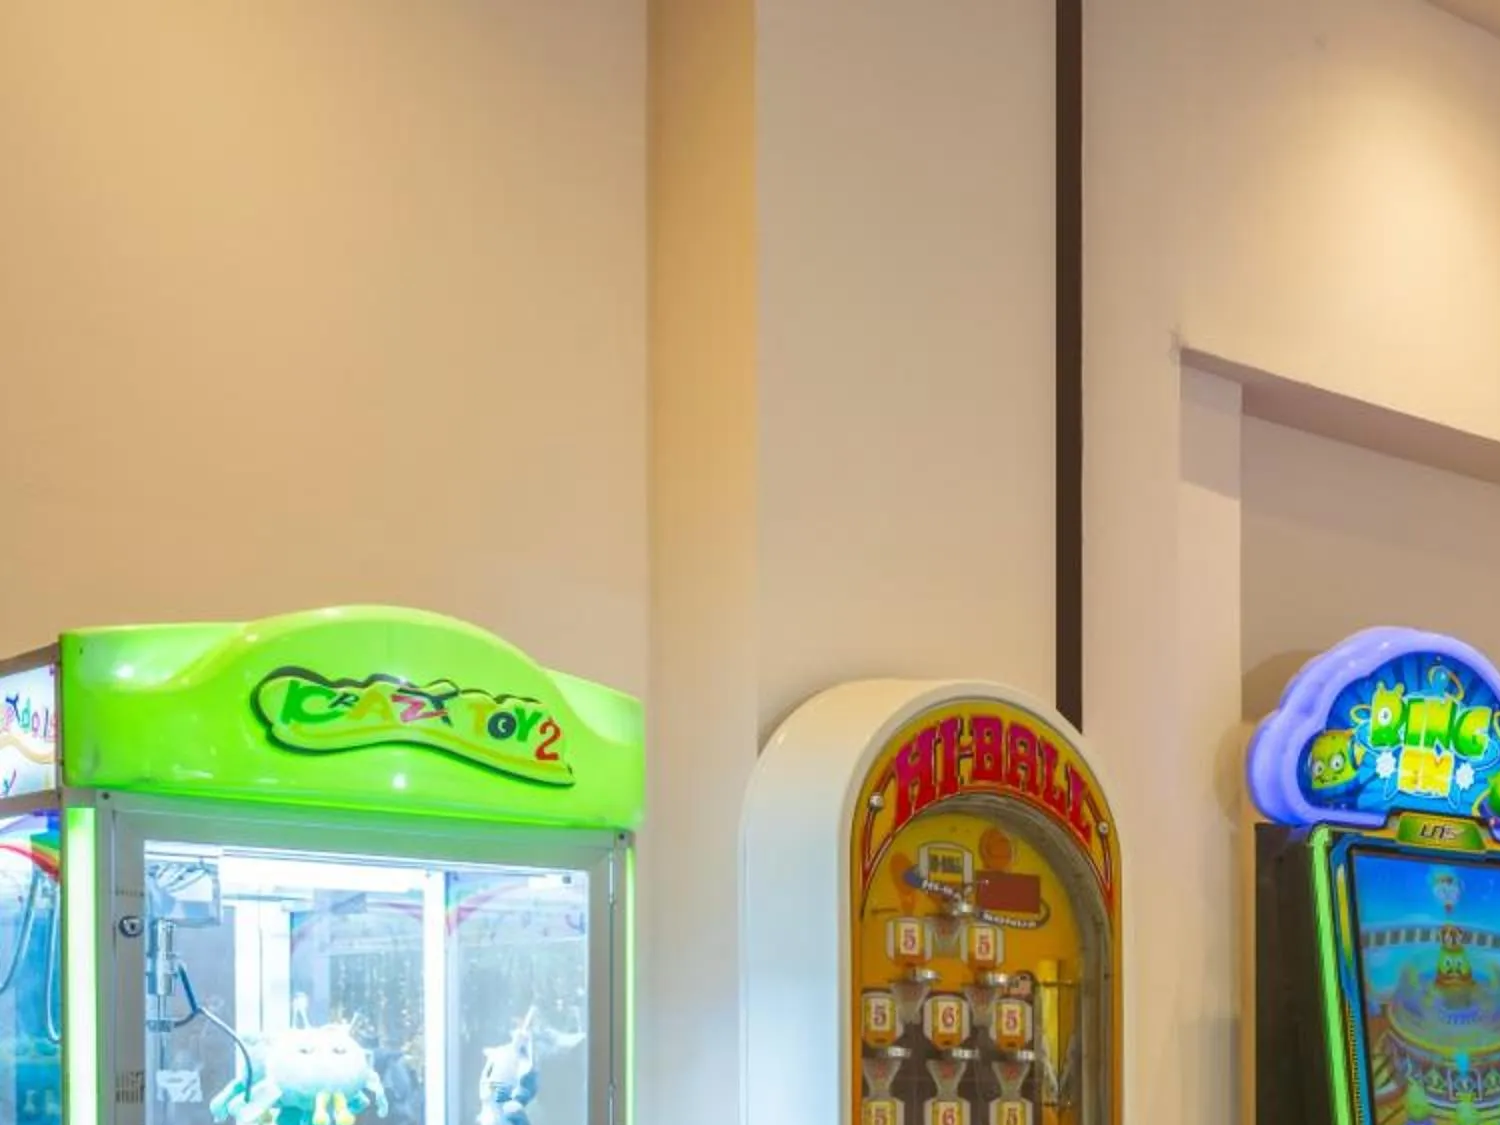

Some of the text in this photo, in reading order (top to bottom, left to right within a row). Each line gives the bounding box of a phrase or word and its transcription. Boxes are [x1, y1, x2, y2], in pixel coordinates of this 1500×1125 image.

[470, 701, 543, 742] TOY
[535, 716, 561, 761] 2
[894, 715, 1092, 847] HI-BALL
